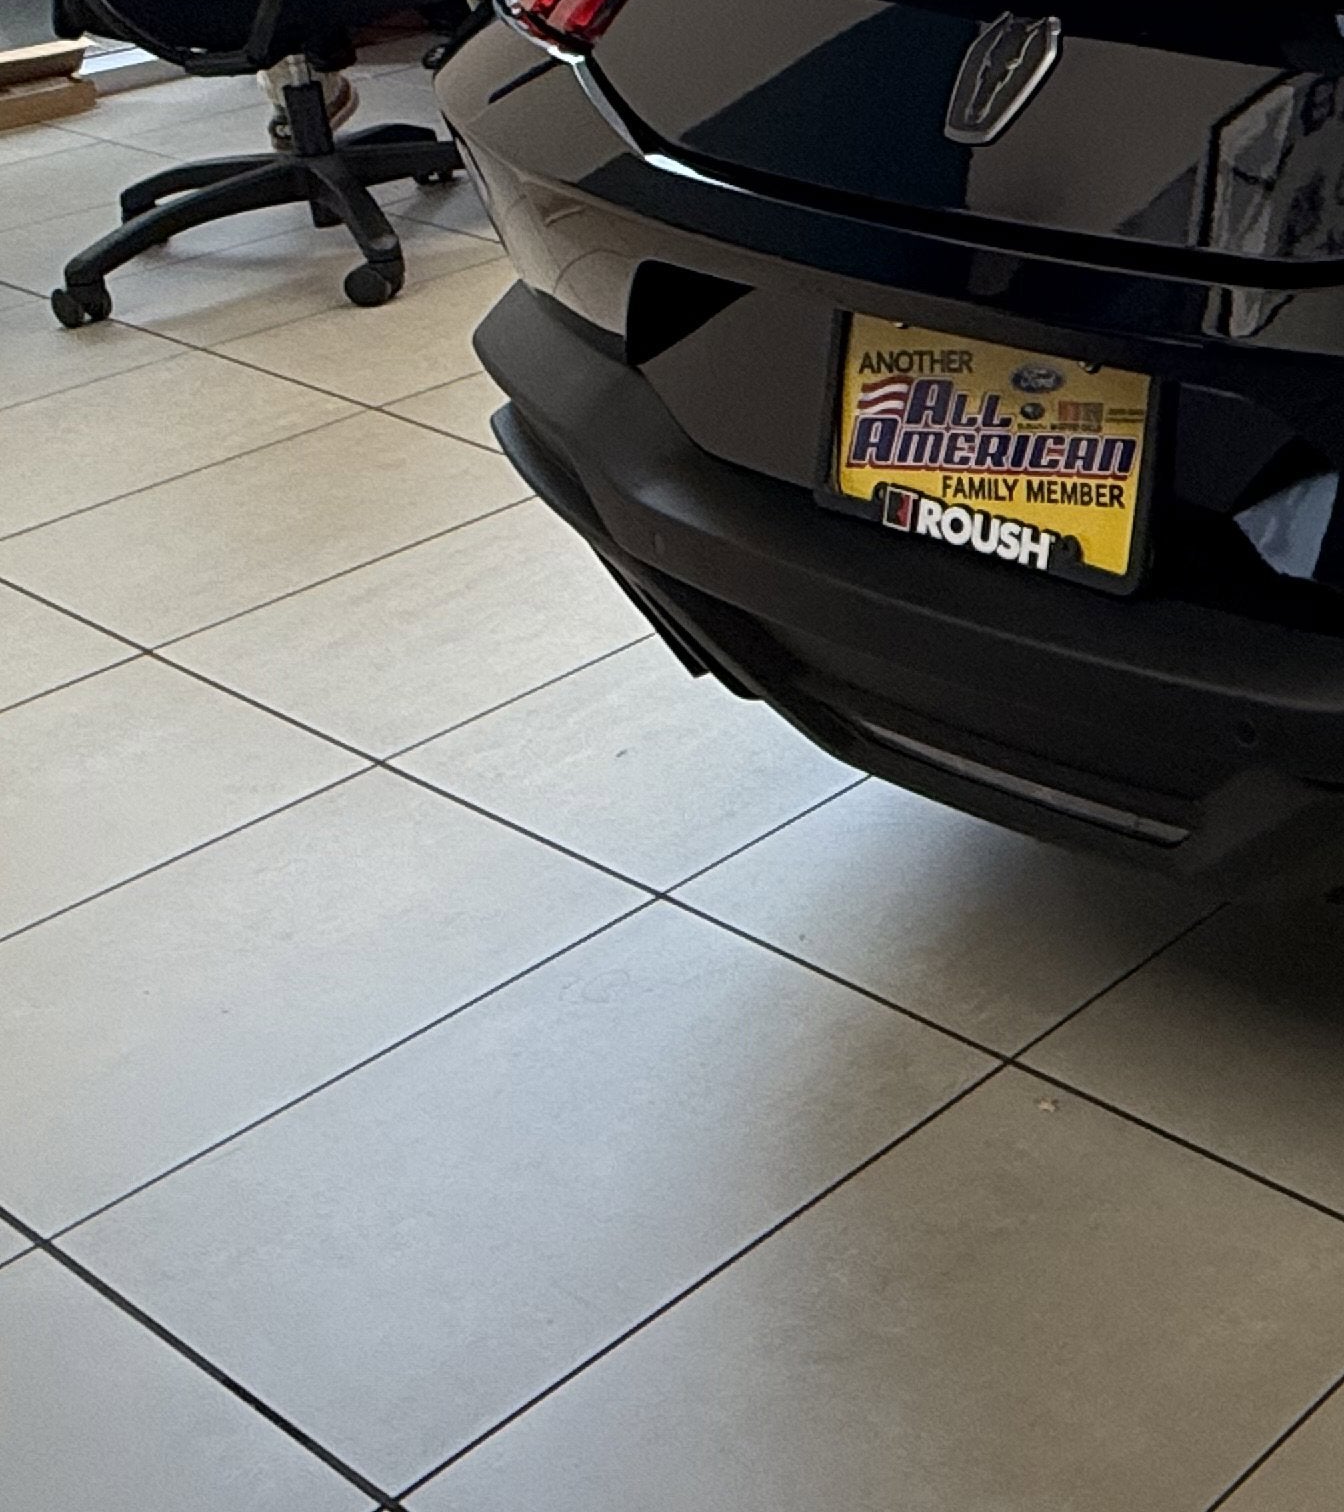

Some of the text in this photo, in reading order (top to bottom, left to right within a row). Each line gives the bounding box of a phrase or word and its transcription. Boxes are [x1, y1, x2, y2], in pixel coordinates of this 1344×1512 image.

[859, 350, 973, 375] ANOTHER
[850, 416, 1138, 476] AMERICAN
[942, 475, 1126, 509] FAMILY MEMBER
[916, 498, 1050, 571] ROUSH
